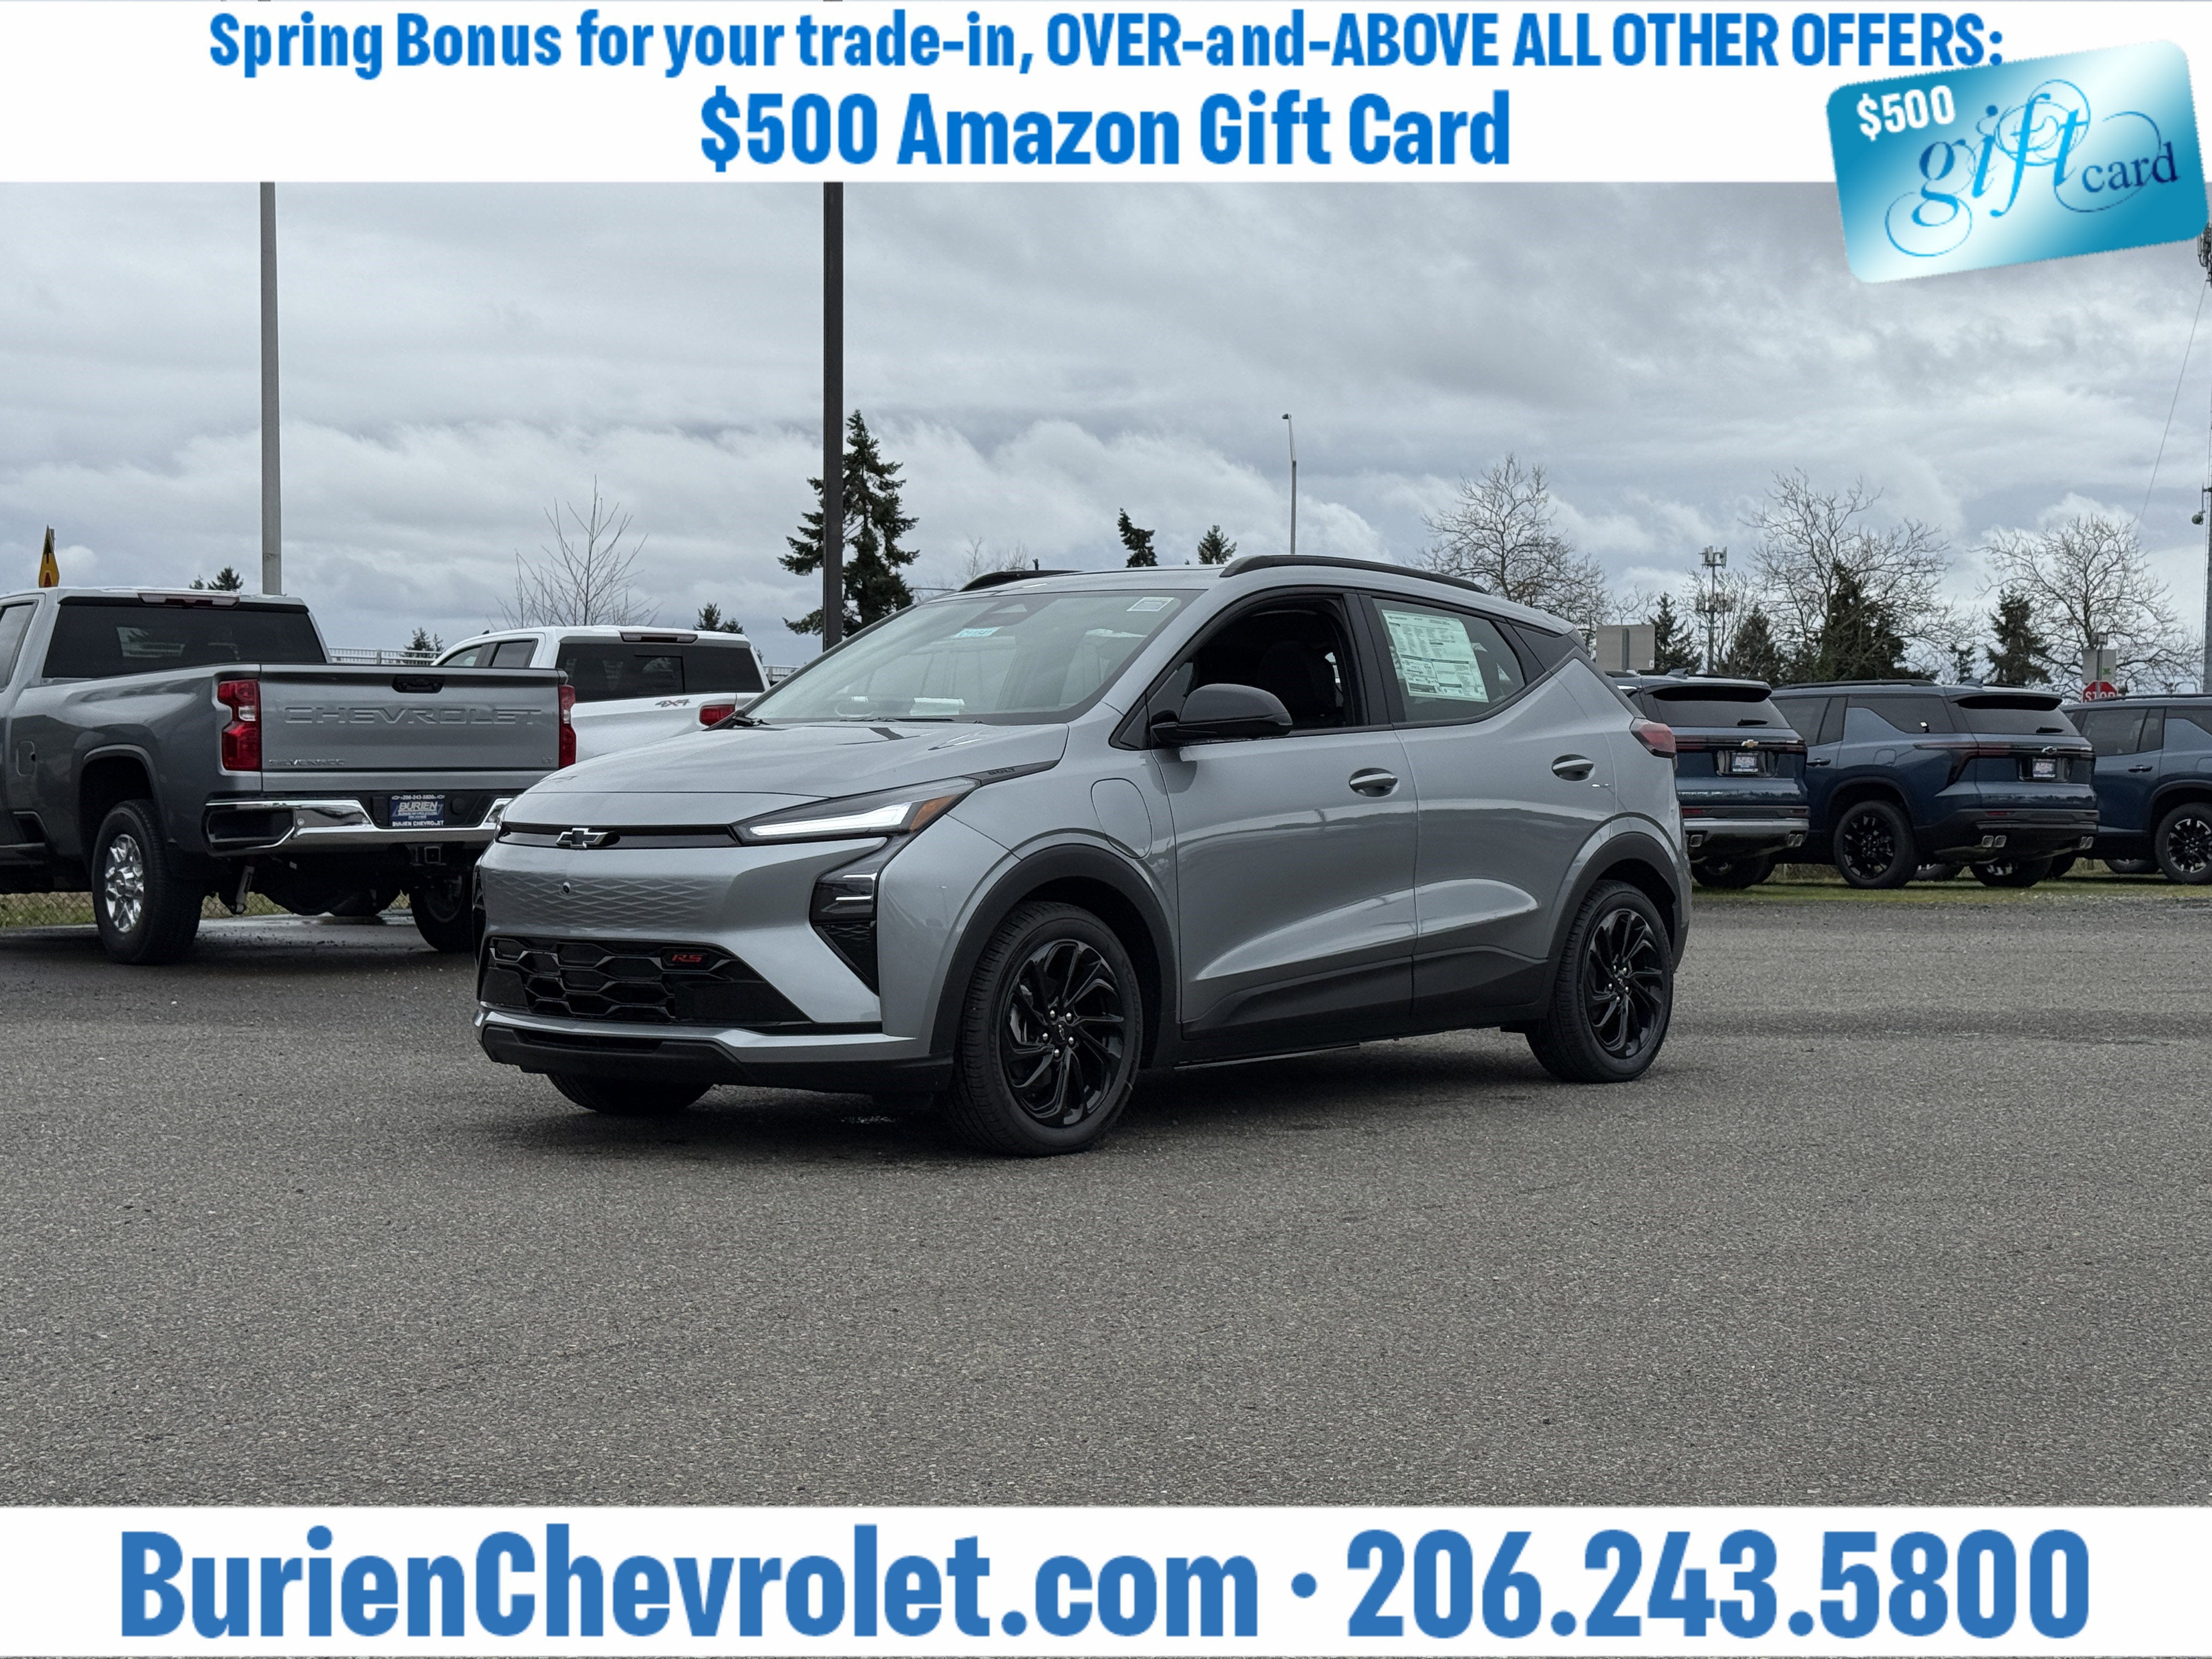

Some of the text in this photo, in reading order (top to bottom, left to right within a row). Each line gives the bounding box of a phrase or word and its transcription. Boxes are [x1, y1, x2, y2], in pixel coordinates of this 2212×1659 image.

[284, 707, 542, 724] CHEVROLET
[399, 801, 438, 811] BURIEN
[672, 954, 703, 963] RS
